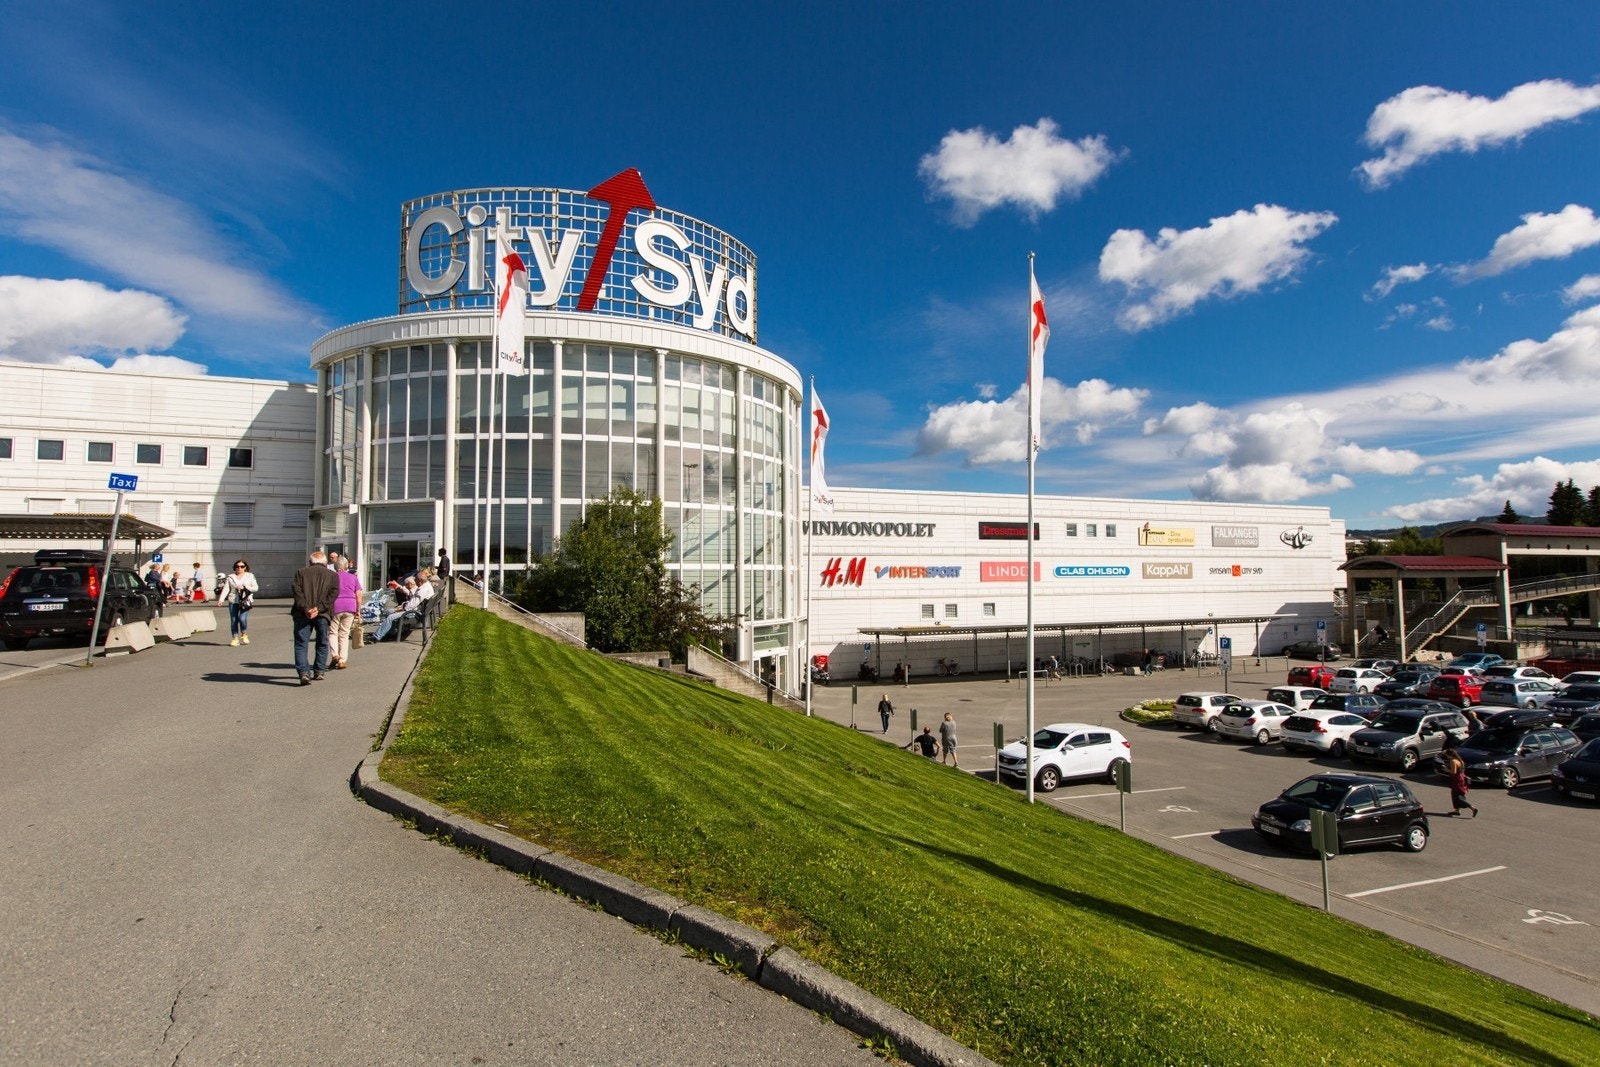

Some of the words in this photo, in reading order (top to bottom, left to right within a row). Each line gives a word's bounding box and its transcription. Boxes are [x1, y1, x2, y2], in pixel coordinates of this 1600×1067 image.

[631, 219, 754, 337] Syd
[111, 476, 137, 488] Taxi
[1214, 527, 1258, 539] FALKANGER
[820, 557, 867, 588] H&M
[889, 566, 961, 579] INTERSPORT
[989, 565, 1037, 577] LINDE
[1060, 567, 1086, 576] CLAS
[1087, 567, 1127, 576] OHLSON
[1146, 564, 1190, 578] KappAhl
[1221, 638, 1229, 648] P
